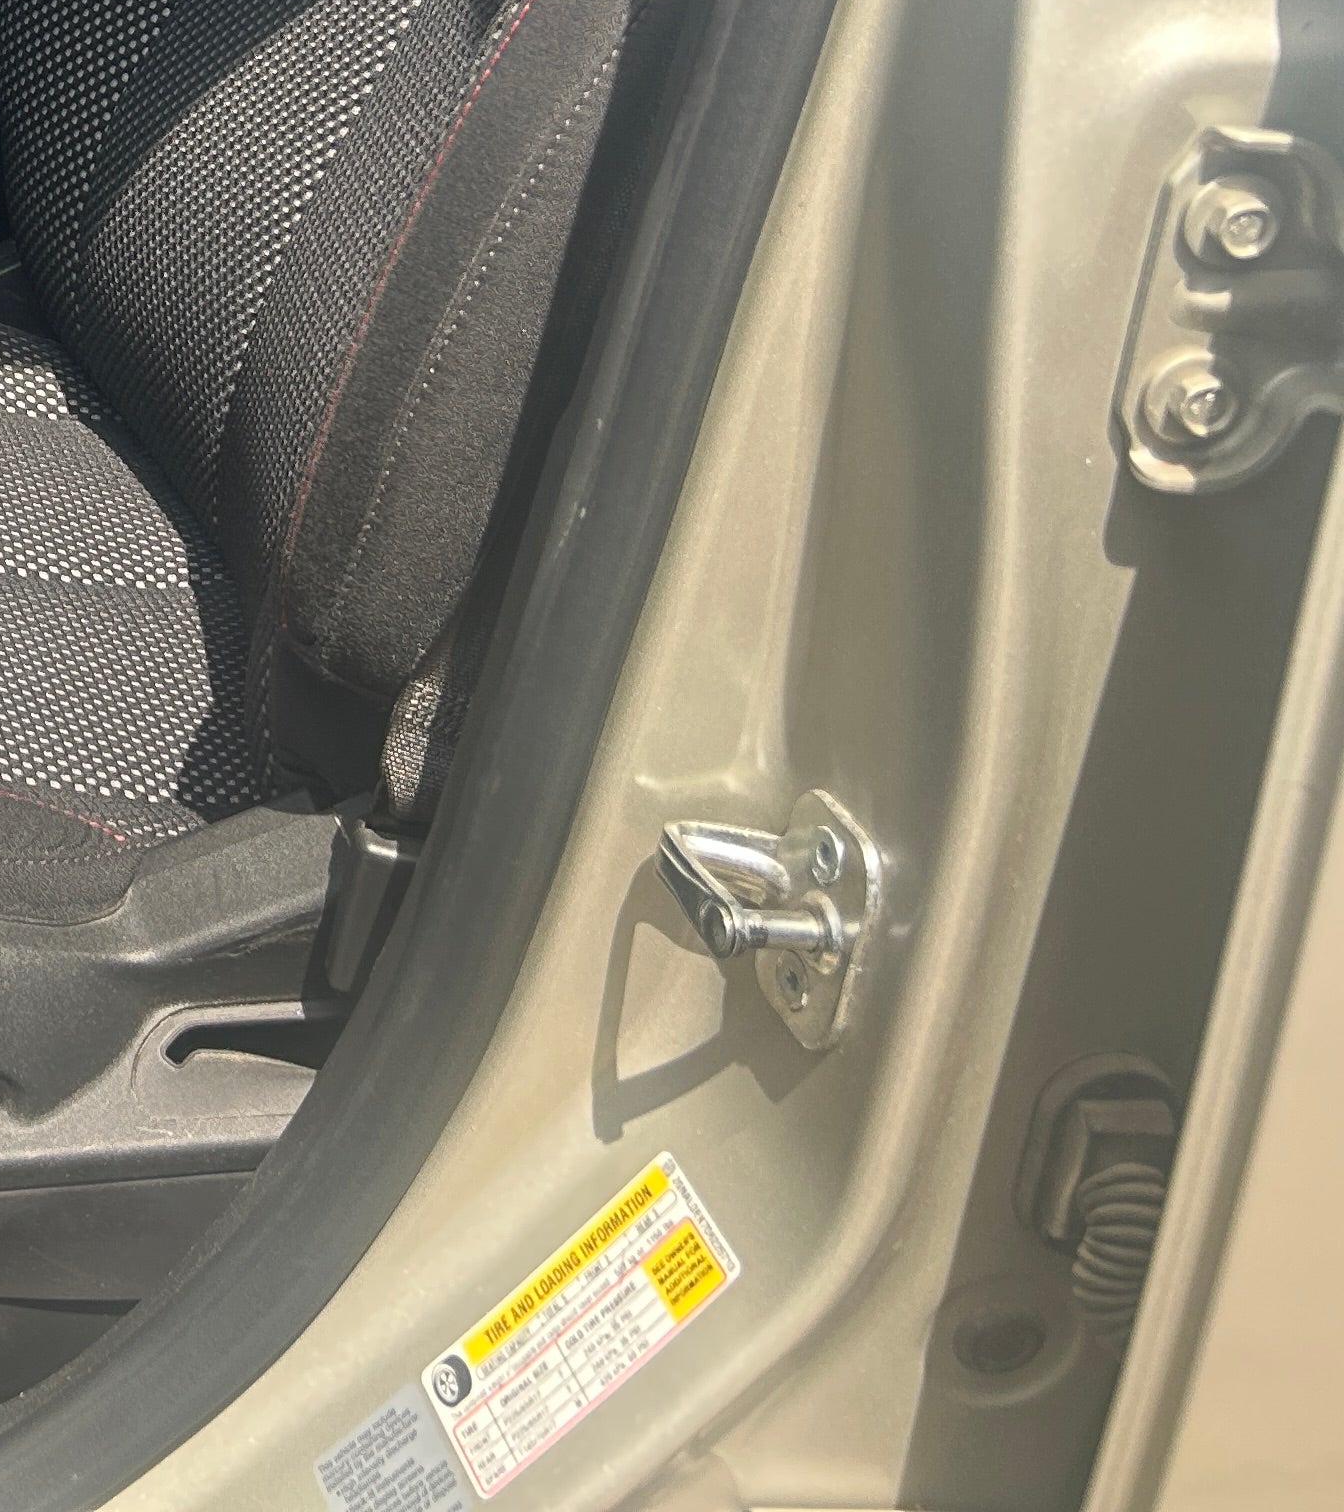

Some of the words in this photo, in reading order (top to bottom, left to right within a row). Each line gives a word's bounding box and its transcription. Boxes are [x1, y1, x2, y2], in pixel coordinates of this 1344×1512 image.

[484, 1313, 512, 1344] TIRE
[510, 1296, 536, 1322] AND
[533, 1251, 581, 1302] LOADING
[579, 1184, 653, 1259] INFORMATION
[652, 1260, 666, 1277] SEE
[657, 1255, 687, 1286] MANUAL
[685, 1241, 701, 1259] FOR
[664, 1254, 707, 1296] ADDITIONAL
[583, 1315, 600, 1334] TIRE
[500, 1377, 532, 1408] ORIGINAL
